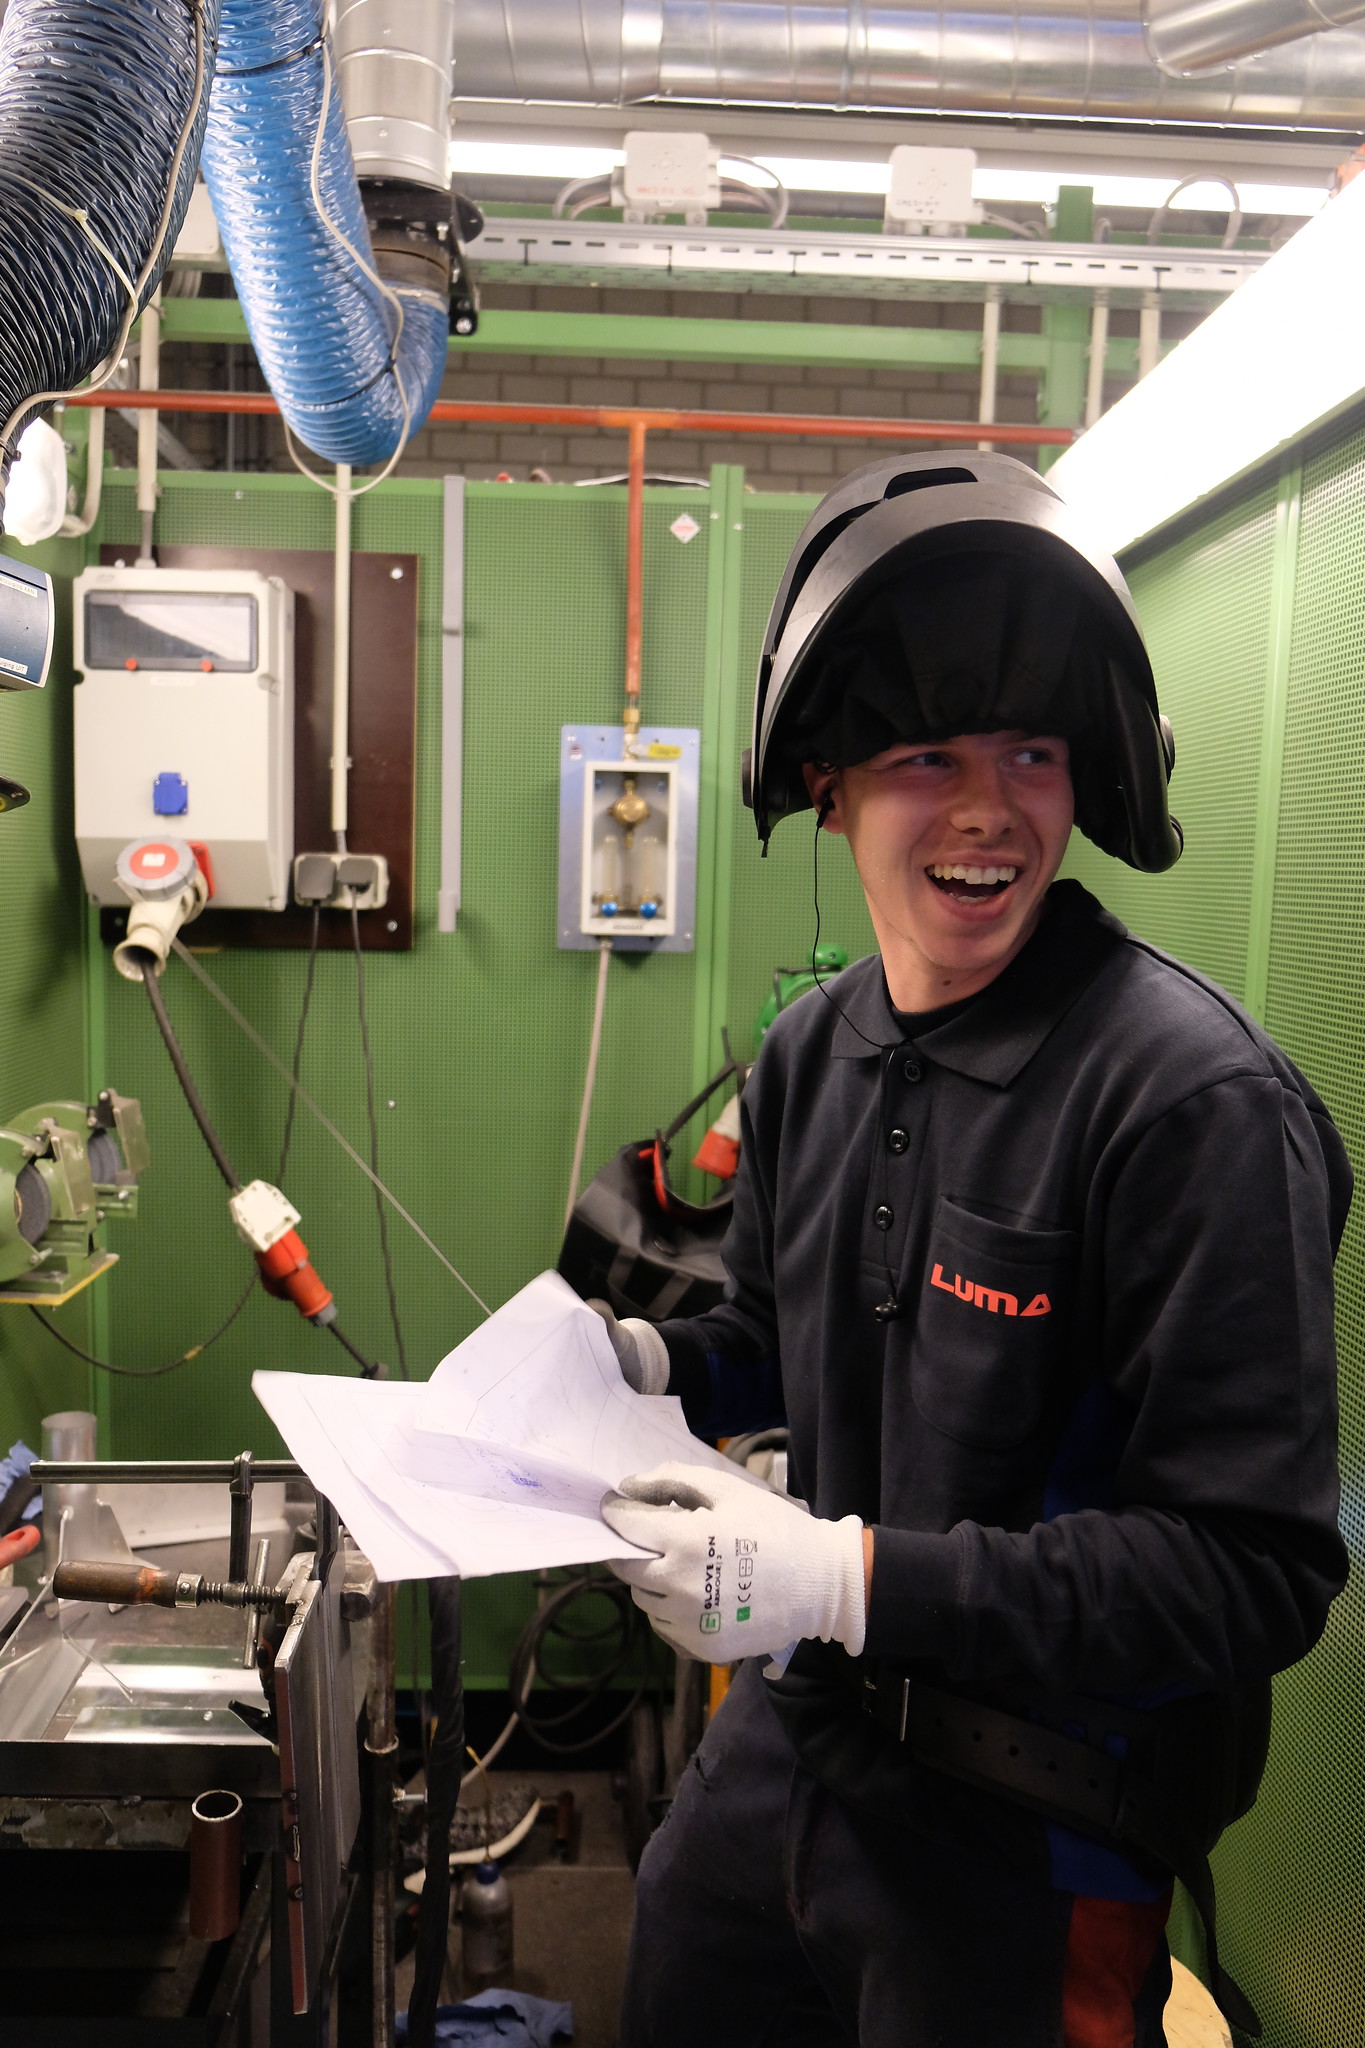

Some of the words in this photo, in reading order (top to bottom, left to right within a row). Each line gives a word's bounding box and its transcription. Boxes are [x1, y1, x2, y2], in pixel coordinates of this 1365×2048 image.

[931, 1263, 1052, 1317] LUMA
[708, 1536, 716, 1557] ON
[704, 1564, 714, 1610] GLOVE
